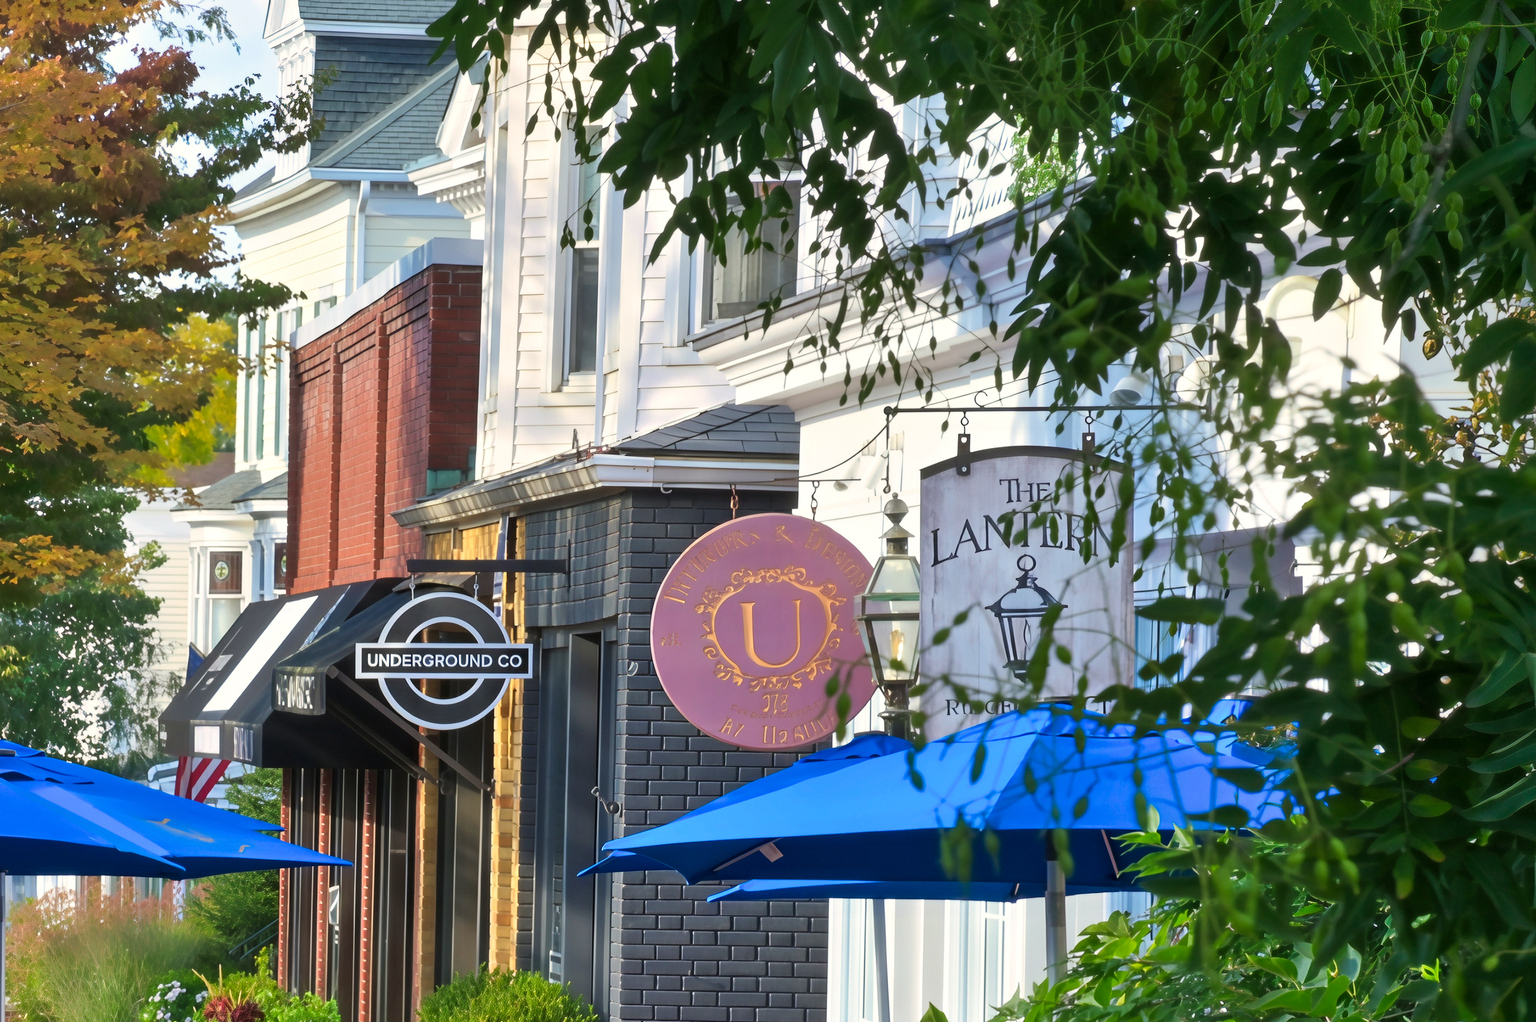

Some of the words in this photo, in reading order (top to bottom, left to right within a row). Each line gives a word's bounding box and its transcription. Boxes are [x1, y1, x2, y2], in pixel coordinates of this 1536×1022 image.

[999, 478, 1051, 504] THE
[739, 599, 802, 668] U
[367, 653, 493, 668] UNDERGROUND
[498, 653, 522, 669] CO
